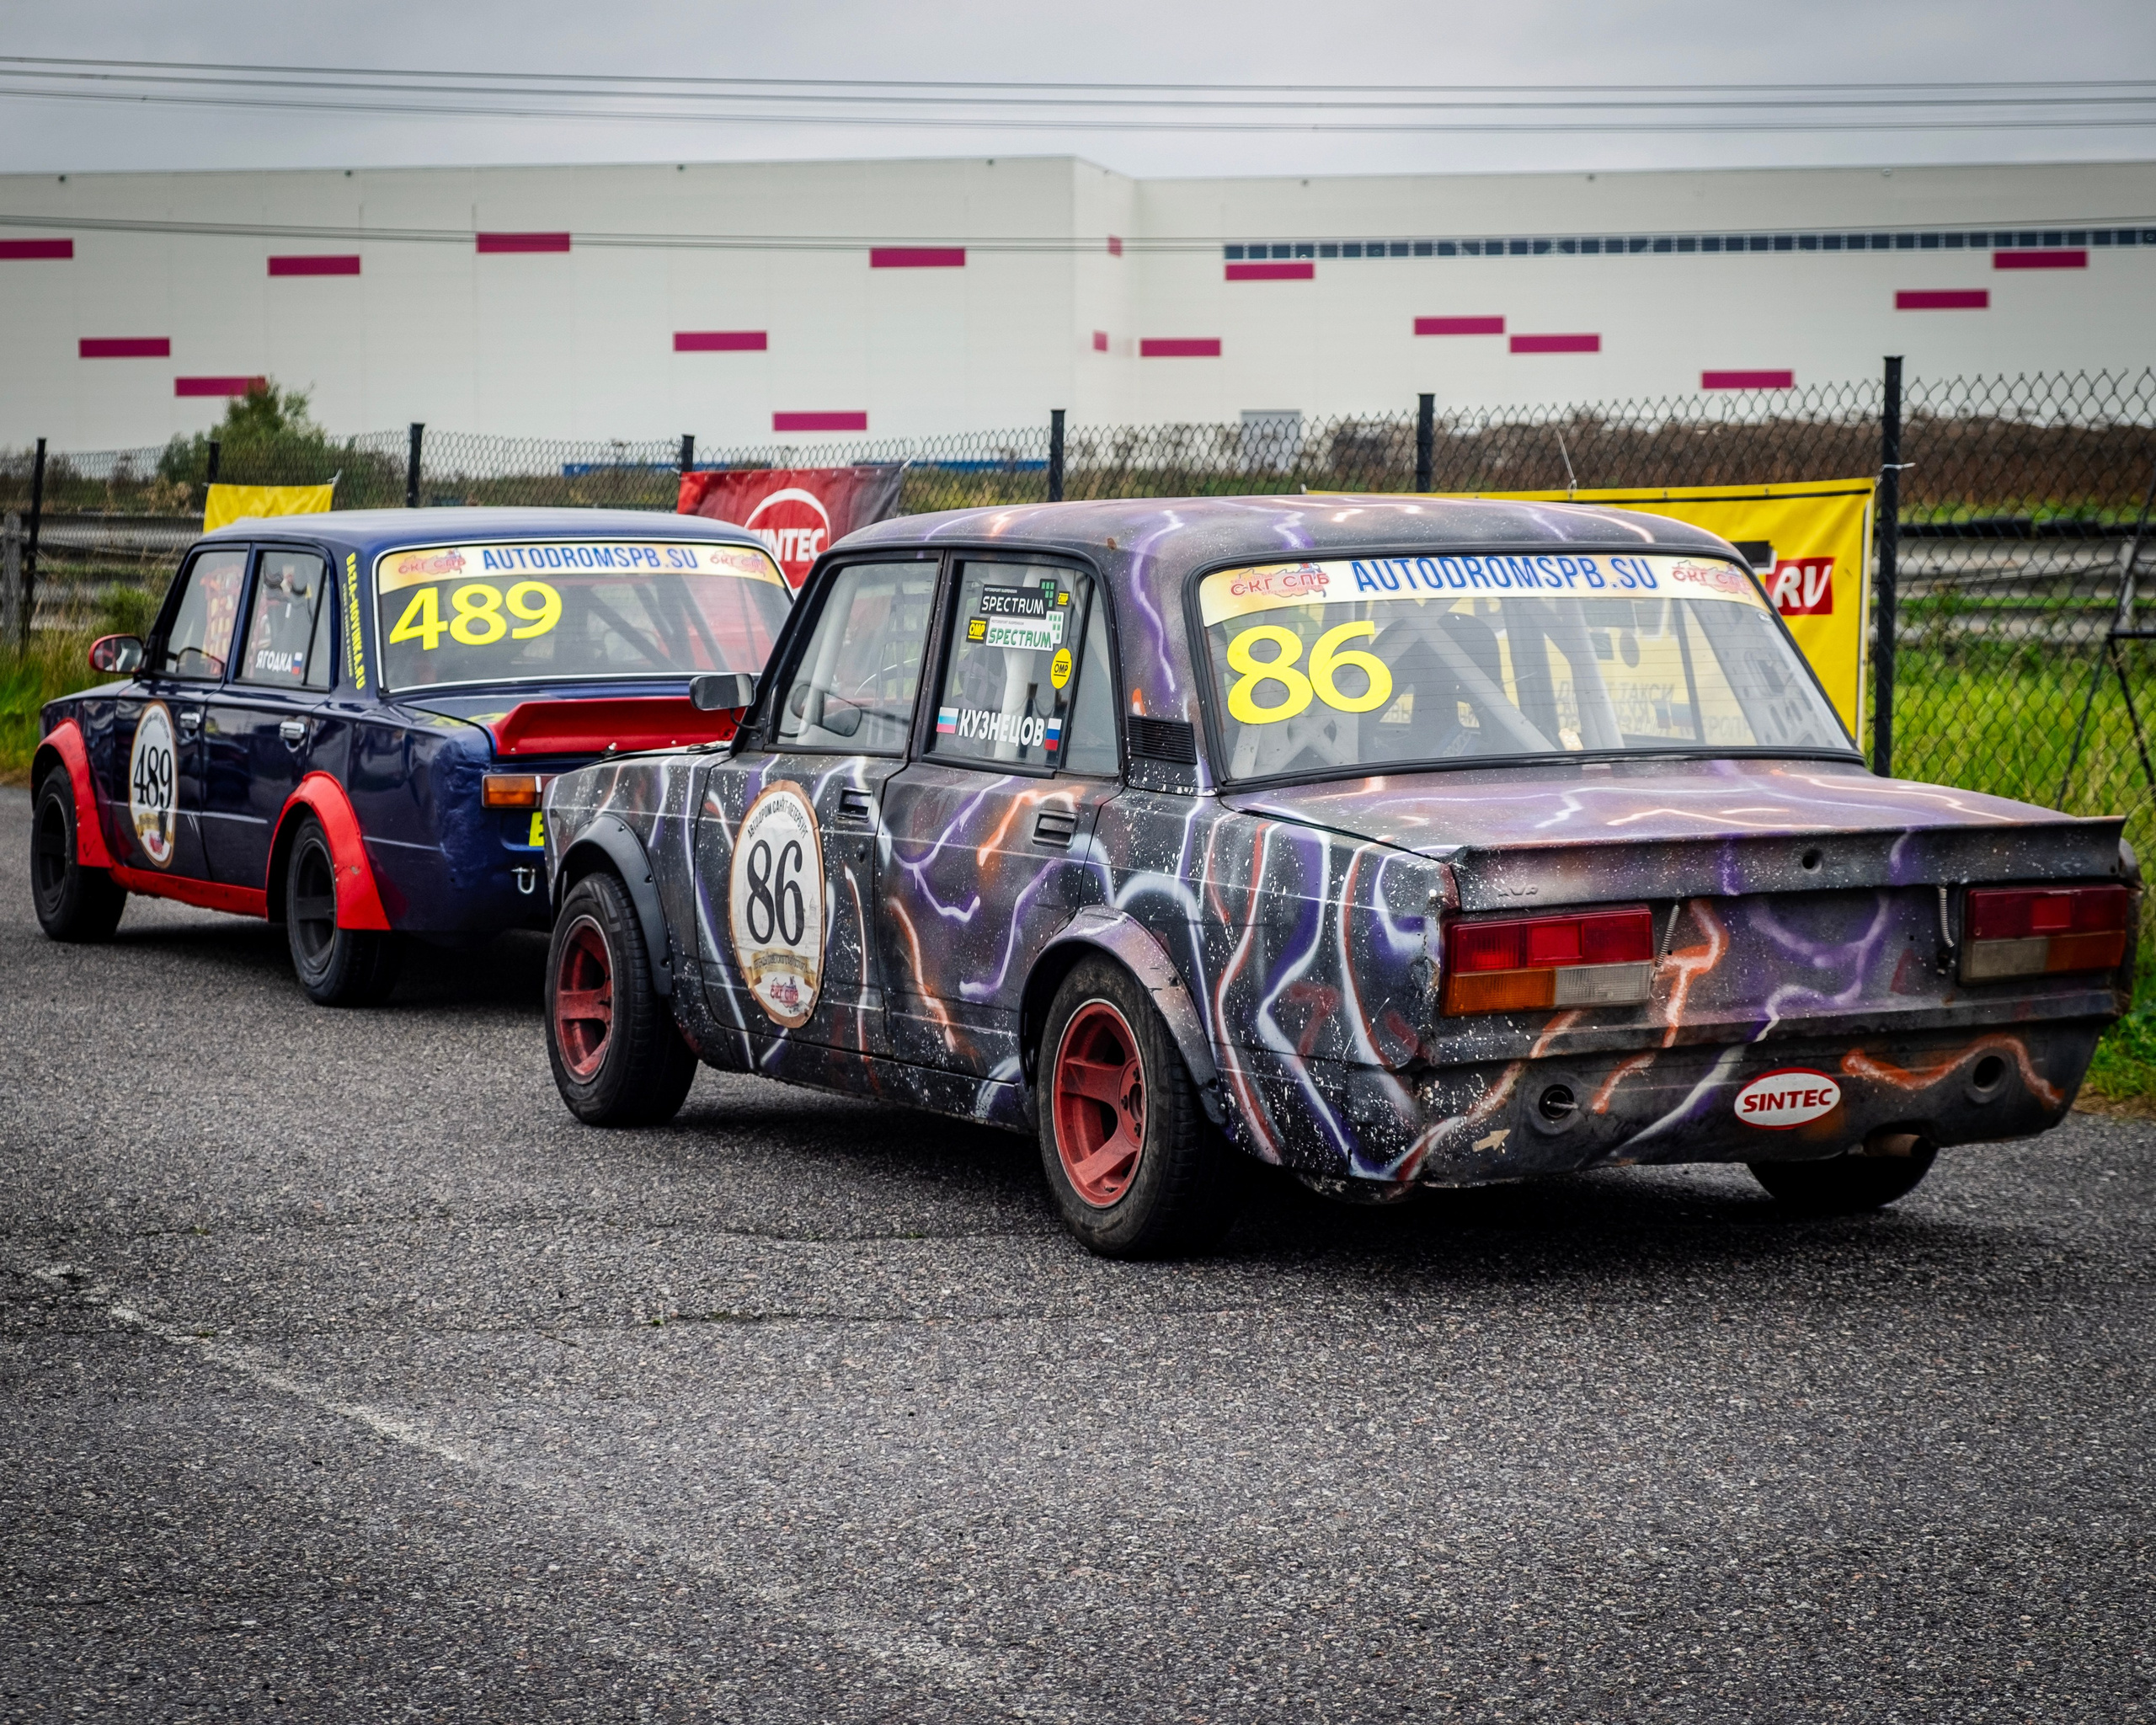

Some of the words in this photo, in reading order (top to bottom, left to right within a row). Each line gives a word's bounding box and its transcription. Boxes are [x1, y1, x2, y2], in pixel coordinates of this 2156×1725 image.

[483, 547, 699, 569] AUTODROMSPB.SU
[1230, 578, 1273, 596] СКГ
[1283, 573, 1330, 588] СПБ
[1350, 556, 1658, 592] AUTODROMSPB.SU
[981, 595, 1044, 615] SPECTRUM
[1058, 595, 1069, 603] OMP
[346, 552, 366, 690] BAZA-NOVINKA.RU
[390, 581, 563, 651] 489
[969, 623, 985, 637] OMP
[988, 628, 1052, 649] SPECTRUM
[255, 650, 292, 673] ЯГОДКА
[1054, 663, 1069, 674] OMP
[1226, 620, 1393, 724] 86
[958, 708, 1045, 747] КУЗНЕЦОВ
[133, 744, 173, 809] 489
[746, 839, 805, 947] 86
[1742, 1087, 1833, 1114] SINTEC
